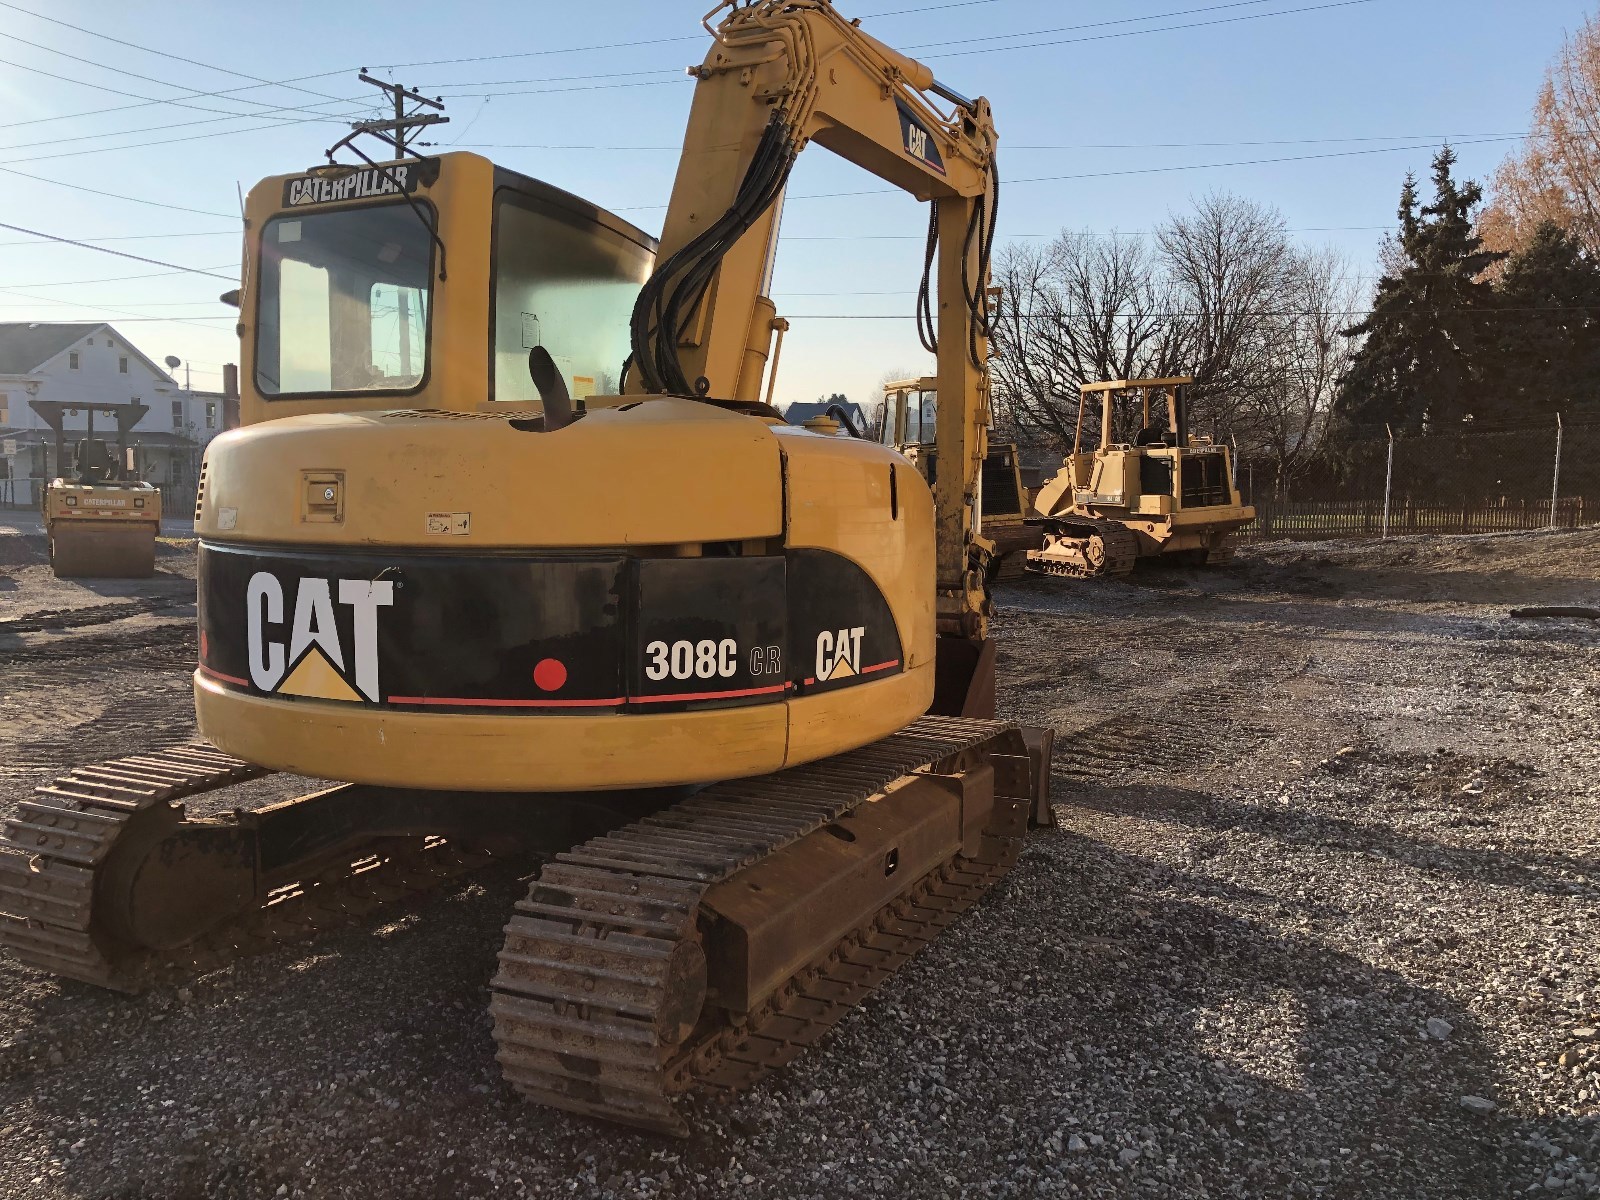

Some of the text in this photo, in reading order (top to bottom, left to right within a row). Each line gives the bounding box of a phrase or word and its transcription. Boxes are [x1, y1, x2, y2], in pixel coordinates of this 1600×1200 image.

[909, 123, 927, 160] CAT
[290, 167, 408, 205] CATERPILLAR
[84, 498, 125, 507] CATERPILLAR
[247, 572, 393, 703] CAT
[816, 626, 865, 682] CAT
[645, 638, 781, 681] 308C CR
